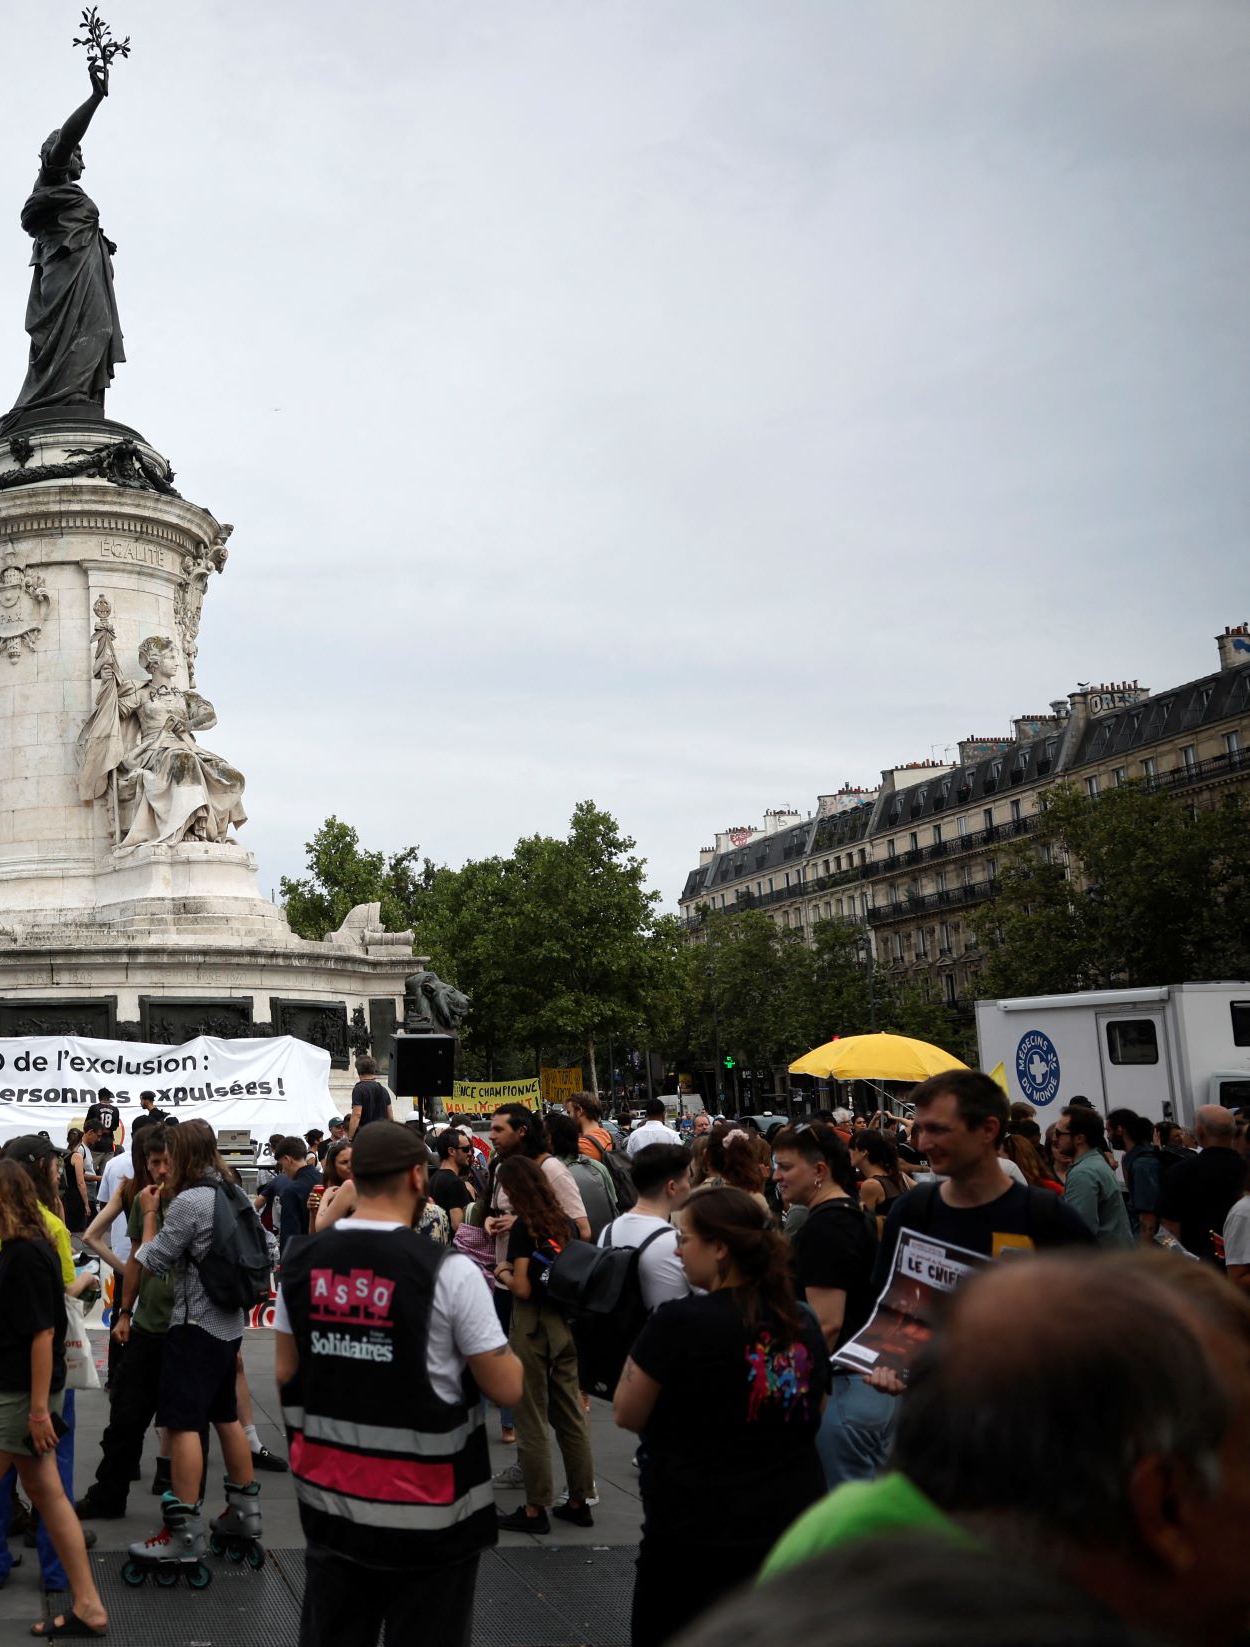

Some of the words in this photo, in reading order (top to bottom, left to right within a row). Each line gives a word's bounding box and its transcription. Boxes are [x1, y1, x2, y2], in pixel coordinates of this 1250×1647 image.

[14, 1051, 48, 1072] de
[1018, 1035, 1048, 1070] MÉDECINS
[154, 1078, 272, 1106] xpulsées
[479, 1080, 538, 1098] CHAMPIONNE
[1021, 1077, 1032, 1094] DU
[1033, 1076, 1057, 1102] MONDE
[100, 1113, 112, 1128] 18
[908, 1256, 923, 1274] LE
[315, 1277, 389, 1308] ASSO
[310, 1330, 394, 1363] Solidaires
